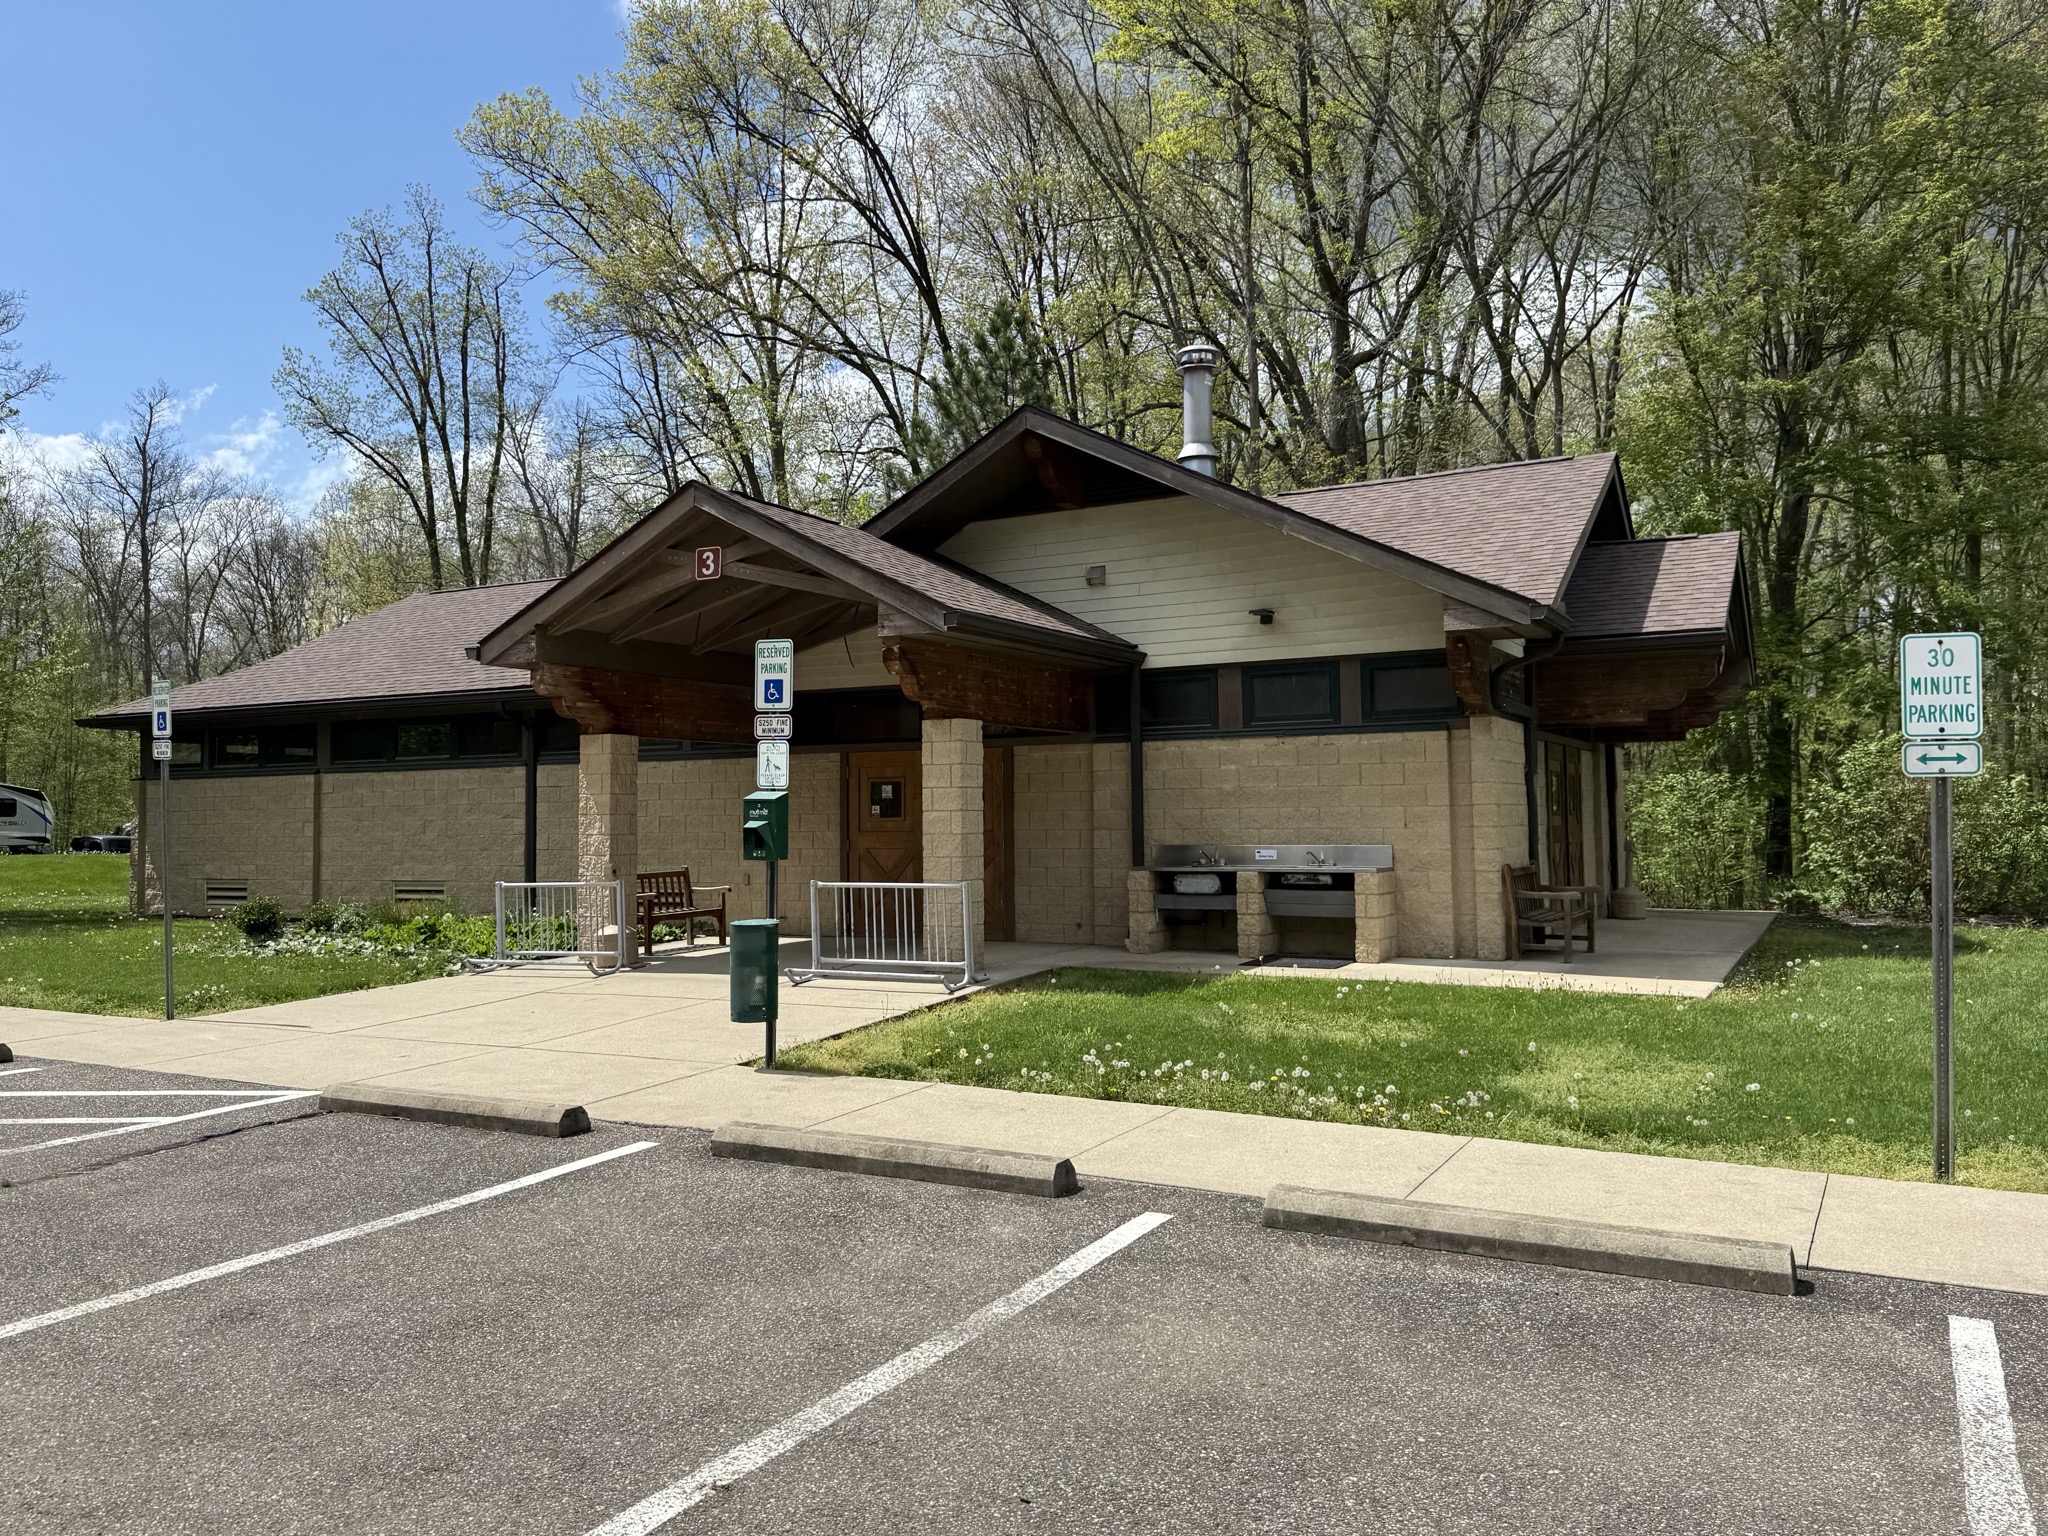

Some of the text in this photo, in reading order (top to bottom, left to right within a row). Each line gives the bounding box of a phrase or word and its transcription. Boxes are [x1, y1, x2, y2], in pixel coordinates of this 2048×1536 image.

[702, 551, 715, 575] 3
[758, 646, 790, 659] RESERVED
[1927, 648, 1955, 667] 30
[760, 663, 788, 674] PARKING
[1910, 676, 1972, 695] MINUTE
[1908, 704, 1976, 723] PARKING
[761, 727, 785, 735] MINIMUM
[776, 719, 789, 727] FINE
